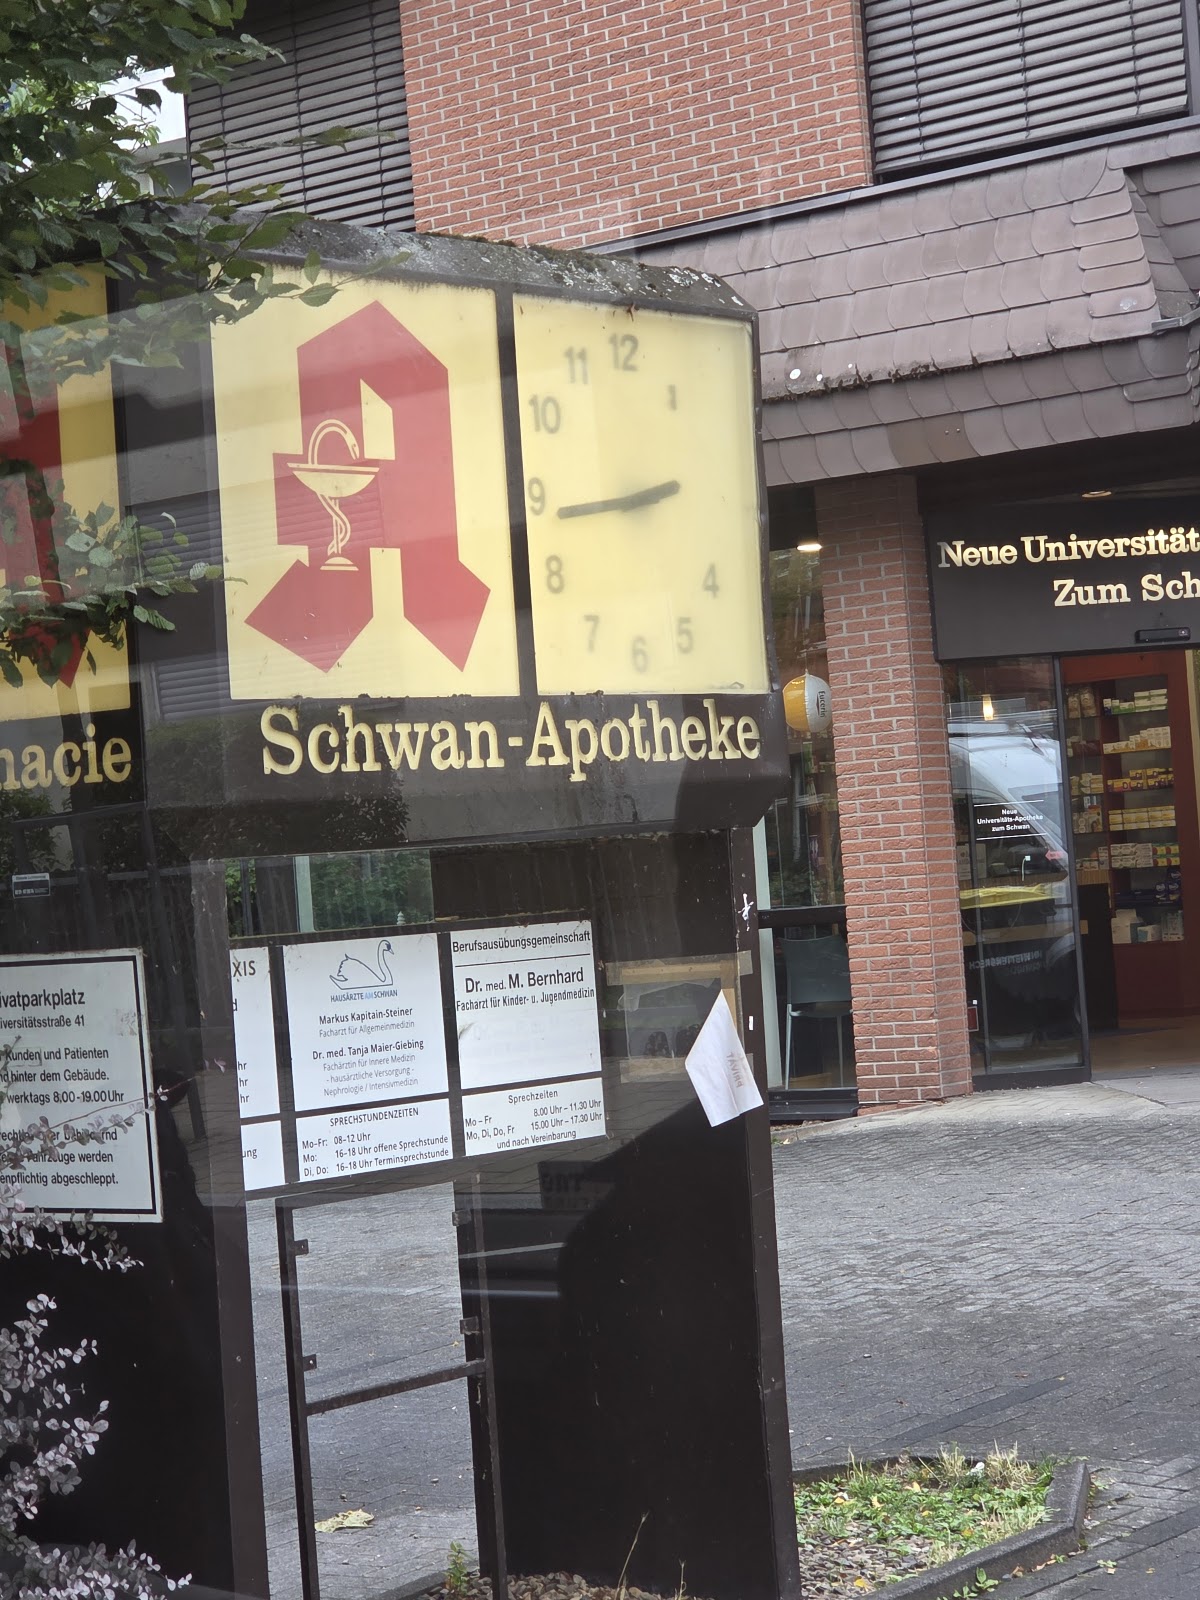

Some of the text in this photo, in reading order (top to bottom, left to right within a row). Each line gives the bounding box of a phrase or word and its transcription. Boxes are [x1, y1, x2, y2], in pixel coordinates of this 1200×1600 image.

[608, 333, 639, 372] 12
[565, 346, 588, 385] 11
[529, 394, 561, 434] 10
[528, 477, 546, 516] 9
[937, 540, 1018, 568] Neue
[545, 554, 565, 594] 8
[702, 563, 720, 598] 4
[1053, 579, 1131, 607] Zum
[584, 614, 600, 654] 7
[677, 617, 694, 655] 5
[631, 636, 649, 674] 6
[260, 699, 760, 782] Schwan-Apotheke
[452, 930, 591, 952] Berufsausübungsgemeinschaft
[465, 967, 584, 993] Dr. med. M. Bernhard
[456, 987, 594, 1011] Facharzt für Kinder- u. Jugendmedizin
[74, 1014, 85, 1027] 41
[320, 1008, 413, 1025] Markus Kapitain-Steiner
[320, 1020, 415, 1038] Facharzt für Allgemeinmedizin
[44, 1048, 61, 1060] und
[64, 1047, 109, 1060] Patienten
[313, 1039, 424, 1060] Dr. med. Tanja Maier-Giebing
[11, 1070, 37, 1082] hinter
[40, 1069, 61, 1082] dem
[63, 1068, 109, 1081] Gebäude.
[323, 1054, 416, 1072] Fachärztin für Innere Medizin
[330, 1071, 373, 1083] hausärztliche
[374, 1067, 410, 1078] Versorgung
[7, 1092, 50, 1106] werktags
[107, 1090, 124, 1102] Uhr
[324, 1085, 363, 1097] Nephrologie
[369, 1078, 418, 1090] Intensivmedizin
[508, 1090, 558, 1105] Sprechzeiten
[330, 1107, 419, 1127] SPRECHSTUNDENZEITEN
[465, 1118, 477, 1128] Mo
[484, 1115, 492, 1124] Fr
[534, 1107, 548, 1117] 8.00
[550, 1105, 562, 1115] Uhr
[569, 1101, 587, 1112] 11.30
[589, 1099, 601, 1109] Uhr
[357, 1132, 371, 1142] Uhr
[466, 1131, 479, 1142] Mo,
[482, 1129, 492, 1139] Di,
[493, 1127, 506, 1137] Do,
[508, 1125, 515, 1134] Fr
[531, 1121, 549, 1131] 15.00
[551, 1119, 563, 1129] Uhr
[570, 1114, 588, 1125] 17.30
[590, 1112, 602, 1122] Uhr
[303, 1153, 317, 1164] Mo:
[357, 1146, 371, 1155] Uhr
[374, 1142, 398, 1153] offene
[399, 1135, 449, 1149] Sprechstunde
[496, 1129, 577, 1150] und nach Vereinbarung
[78, 1150, 114, 1163] werden
[316, 1165, 329, 1175] Do:
[359, 1159, 372, 1169] Uhr
[374, 1148, 449, 1167] Terminsprechstunde
[51, 1171, 119, 1187] abgeschleppt.
